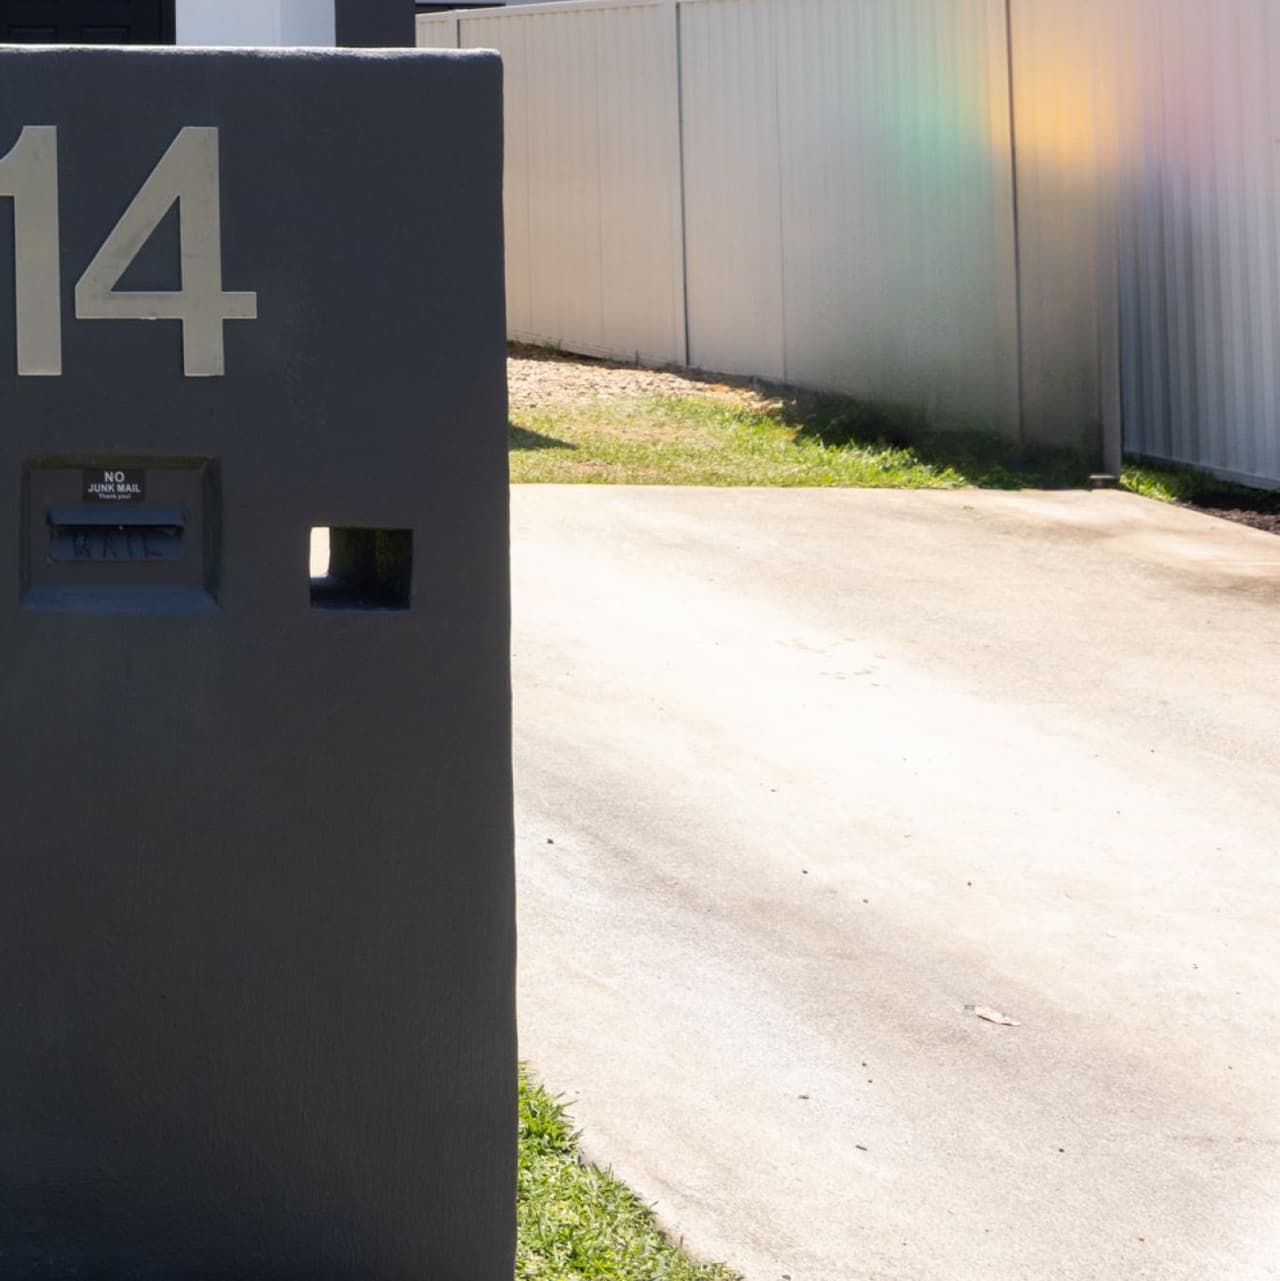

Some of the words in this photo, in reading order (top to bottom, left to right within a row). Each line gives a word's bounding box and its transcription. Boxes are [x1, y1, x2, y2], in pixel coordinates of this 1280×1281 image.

[104, 471, 125, 482] NO
[88, 484, 115, 493] JUNK
[117, 484, 141, 493] MAIL
